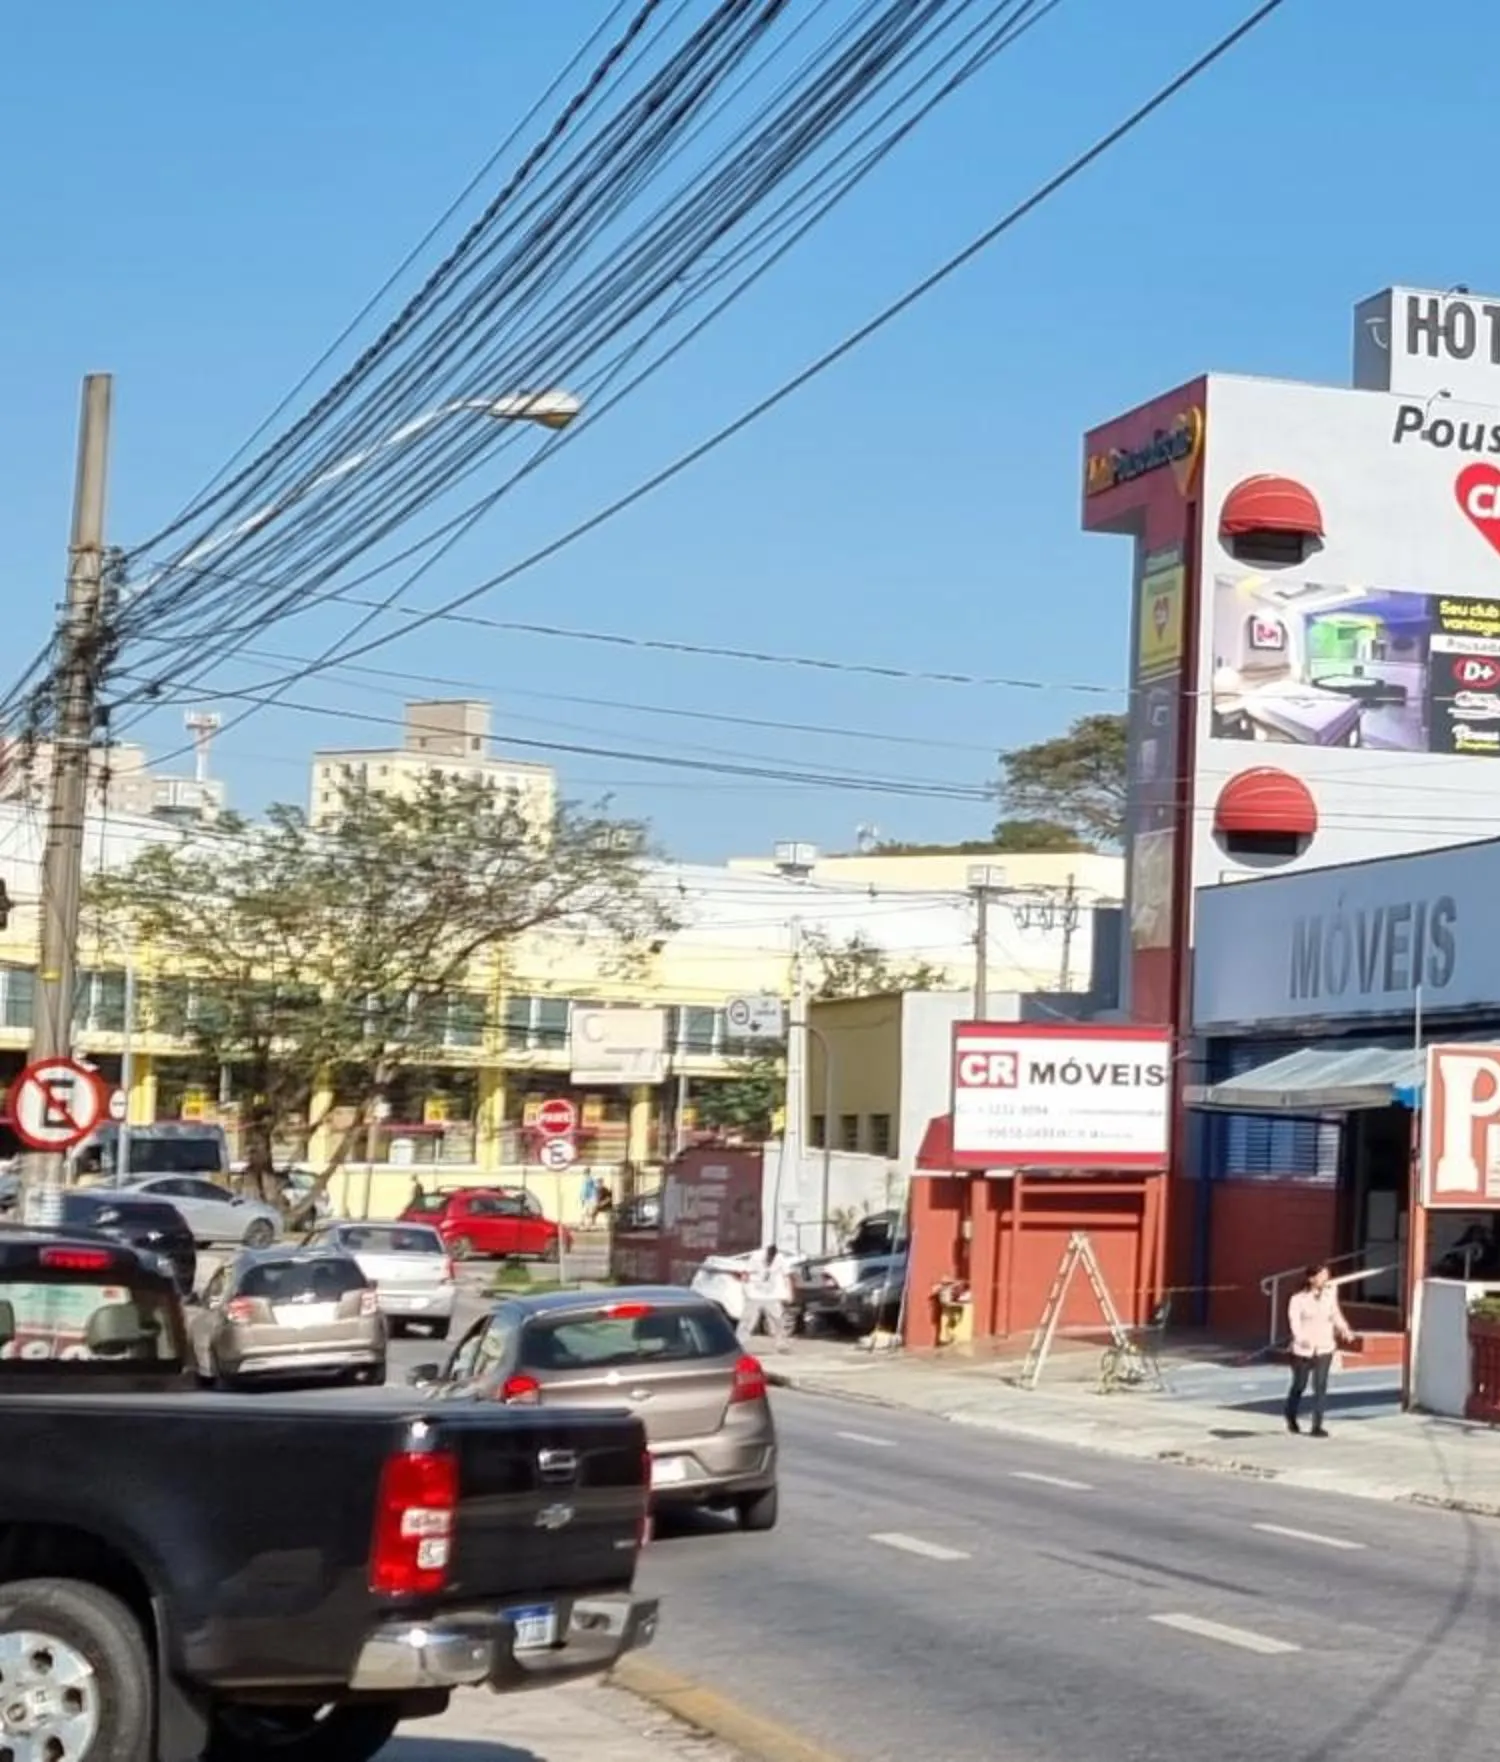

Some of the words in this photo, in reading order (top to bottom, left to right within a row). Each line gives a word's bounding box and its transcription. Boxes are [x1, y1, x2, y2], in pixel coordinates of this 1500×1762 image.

[1440, 600, 1467, 615] Seu
[1470, 602, 1499, 618] club
[1289, 889, 1458, 1001] MÓVEIS
[960, 1053, 1016, 1086] CR
[1030, 1056, 1165, 1087] MÓVEIS
